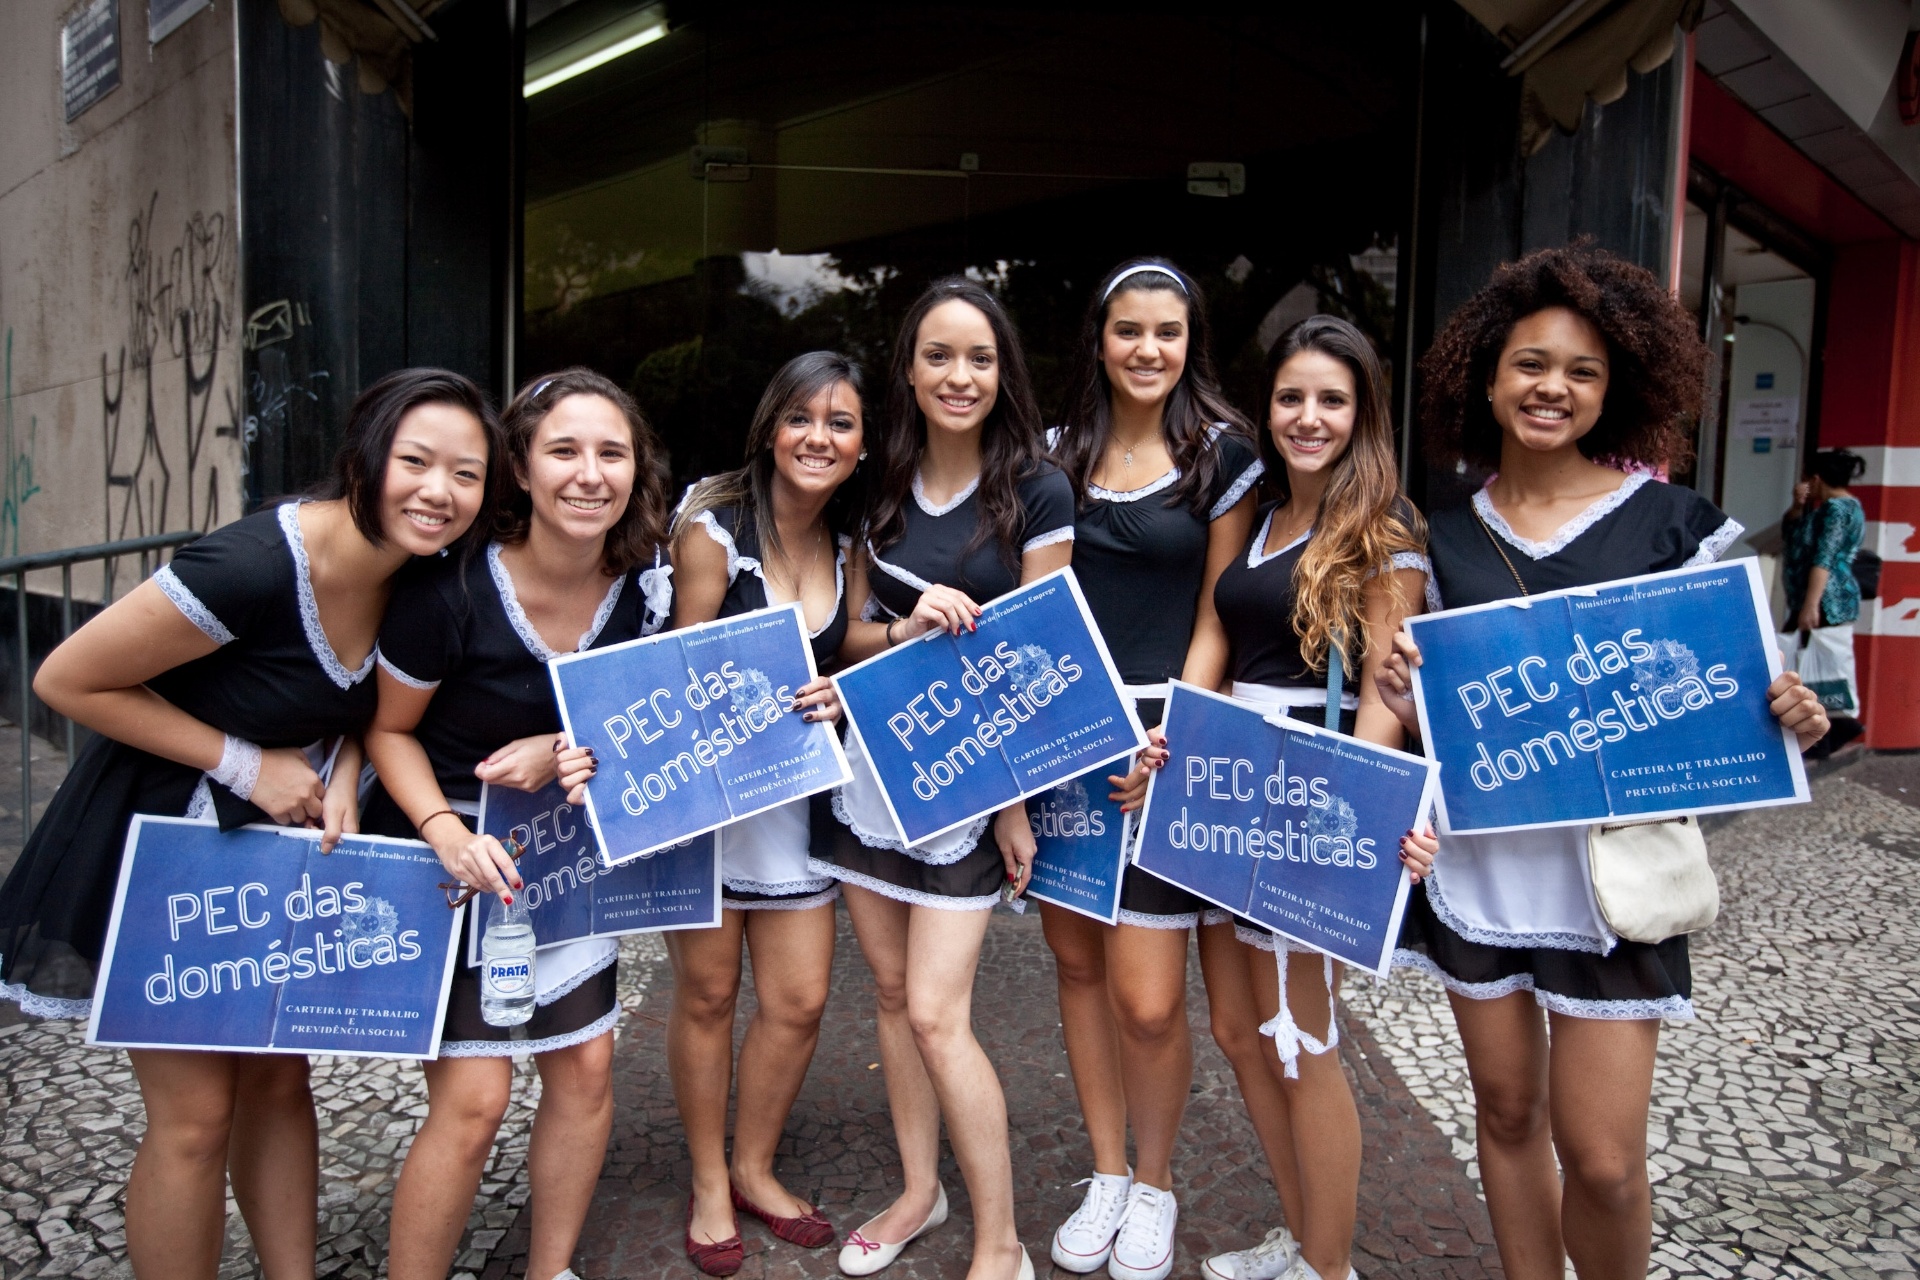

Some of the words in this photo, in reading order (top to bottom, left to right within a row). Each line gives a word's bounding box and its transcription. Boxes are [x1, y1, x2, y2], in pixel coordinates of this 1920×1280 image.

[987, 615, 996, 623] do
[996, 601, 1024, 618] Trabalho
[1028, 587, 1056, 604] Emprego
[1575, 596, 1620, 610] Ministério
[1636, 586, 1676, 600] Trabalho
[1686, 577, 1728, 591] Emprego
[686, 635, 718, 648] Ministério
[718, 632, 727, 640] do
[727, 626, 754, 638] Trabalho
[759, 618, 786, 629] Emprego
[886, 680, 962, 752] PEC
[960, 640, 1020, 696] das
[1456, 655, 1559, 730] PEC
[1566, 628, 1654, 686] das
[603, 688, 683, 760] PEC
[684, 660, 742, 711] das
[912, 654, 1083, 801] domésticas
[1469, 663, 1740, 792] domésticas
[620, 685, 796, 817] domésticas
[1013, 742, 1056, 764] CARTEIRA
[1056, 735, 1068, 746] DE
[1068, 716, 1113, 740] TRABALHO
[1026, 749, 1083, 777] PREVIDÊNCIA
[1082, 735, 1114, 752] SOCIAL
[1064, 744, 1070, 752] E
[1290, 734, 1325, 750] Ministério
[1325, 746, 1335, 754] do
[1336, 749, 1368, 764] Trabalho
[1376, 760, 1410, 777] Emprego
[727, 768, 768, 786] CARTEIRA
[768, 763, 779, 773] DE
[779, 749, 821, 768] TRABALHO
[739, 777, 792, 800] PREVIDÊNCIA
[792, 766, 822, 782] SOCIAL
[1185, 755, 1254, 802] PEC
[1264, 758, 1330, 807] das
[1611, 764, 1674, 779] CARTEIRA
[1676, 761, 1693, 771] DE
[1694, 752, 1766, 769] TRABALHO
[1685, 772, 1693, 781] E
[1625, 782, 1710, 798] PREVIDÊNCIA
[1712, 775, 1761, 788] SOCIAL
[510, 802, 576, 866] PEC
[1168, 806, 1378, 870] domésticas
[358, 849, 369, 858] do
[370, 850, 406, 862] Trabalho
[1058, 867, 1068, 875] DE
[1068, 870, 1106, 887] TRABALHO
[1073, 888, 1099, 900] SOCIAL
[167, 882, 270, 942] PEC
[284, 872, 366, 922] das
[597, 893, 640, 905] CARTEIRA
[654, 888, 701, 898] TRABALHO
[604, 907, 661, 920] PREVIDÊNCIA
[662, 904, 695, 912] SOCIAL
[1259, 880, 1303, 904] CARTEIRA
[1304, 900, 1317, 910] DE
[1319, 904, 1371, 931] TRABALHO
[1308, 910, 1314, 919] E
[1262, 900, 1322, 932] PREVIDÊNCIA
[1323, 926, 1359, 947] SOCIAL
[145, 928, 422, 1005] domésticas
[490, 964, 528, 979] PRATA
[285, 1004, 342, 1015] CARTEIRA
[344, 1008, 359, 1016] DE
[361, 1008, 420, 1019] TRABALHO
[348, 1017, 356, 1026] E
[291, 1024, 366, 1036] PREVIDÊNCIA
[368, 1028, 408, 1038] SOCIAL
